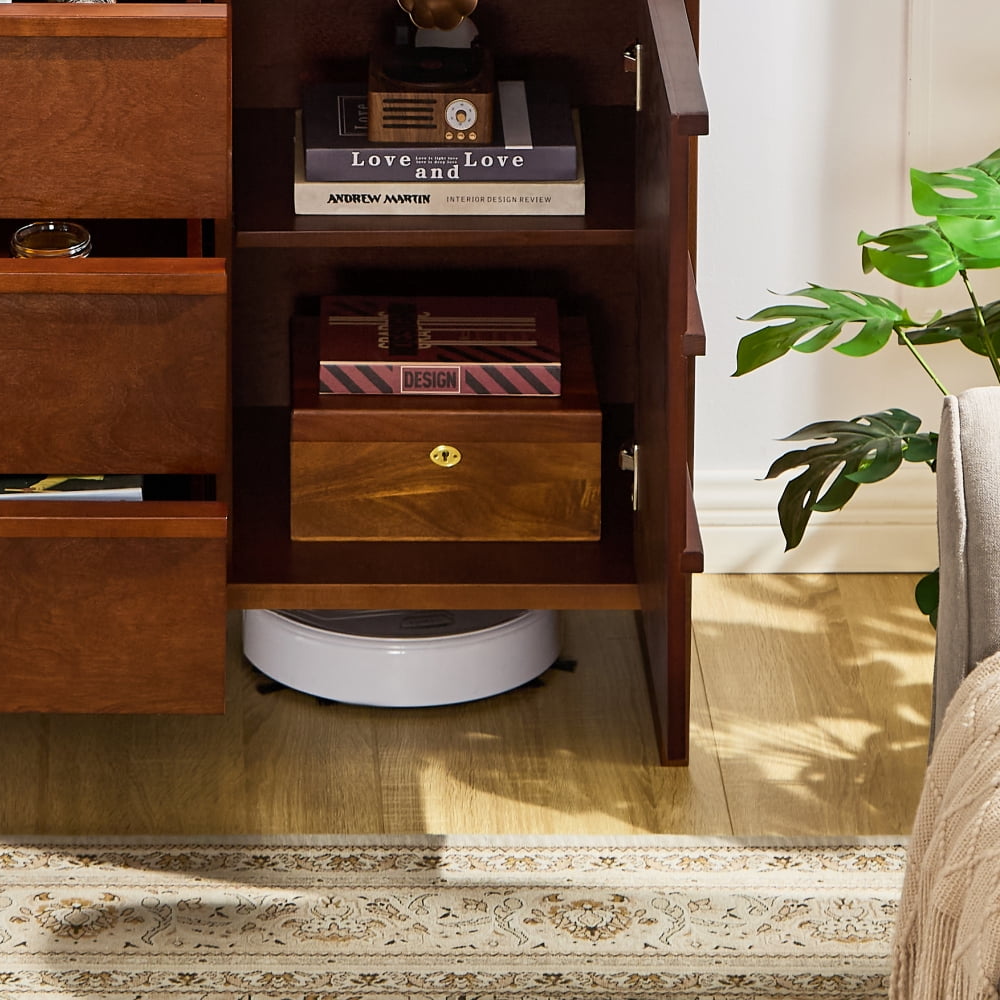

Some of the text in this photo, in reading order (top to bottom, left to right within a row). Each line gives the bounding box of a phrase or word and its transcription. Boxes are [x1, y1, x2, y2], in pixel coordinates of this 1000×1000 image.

[351, 151, 525, 167] Love Love
[415, 164, 460, 179] and
[327, 193, 432, 204] ANDREW MARTIN
[446, 196, 552, 204] INTERIOR DESIGN REVIEW
[404, 371, 457, 389] DESIGN
